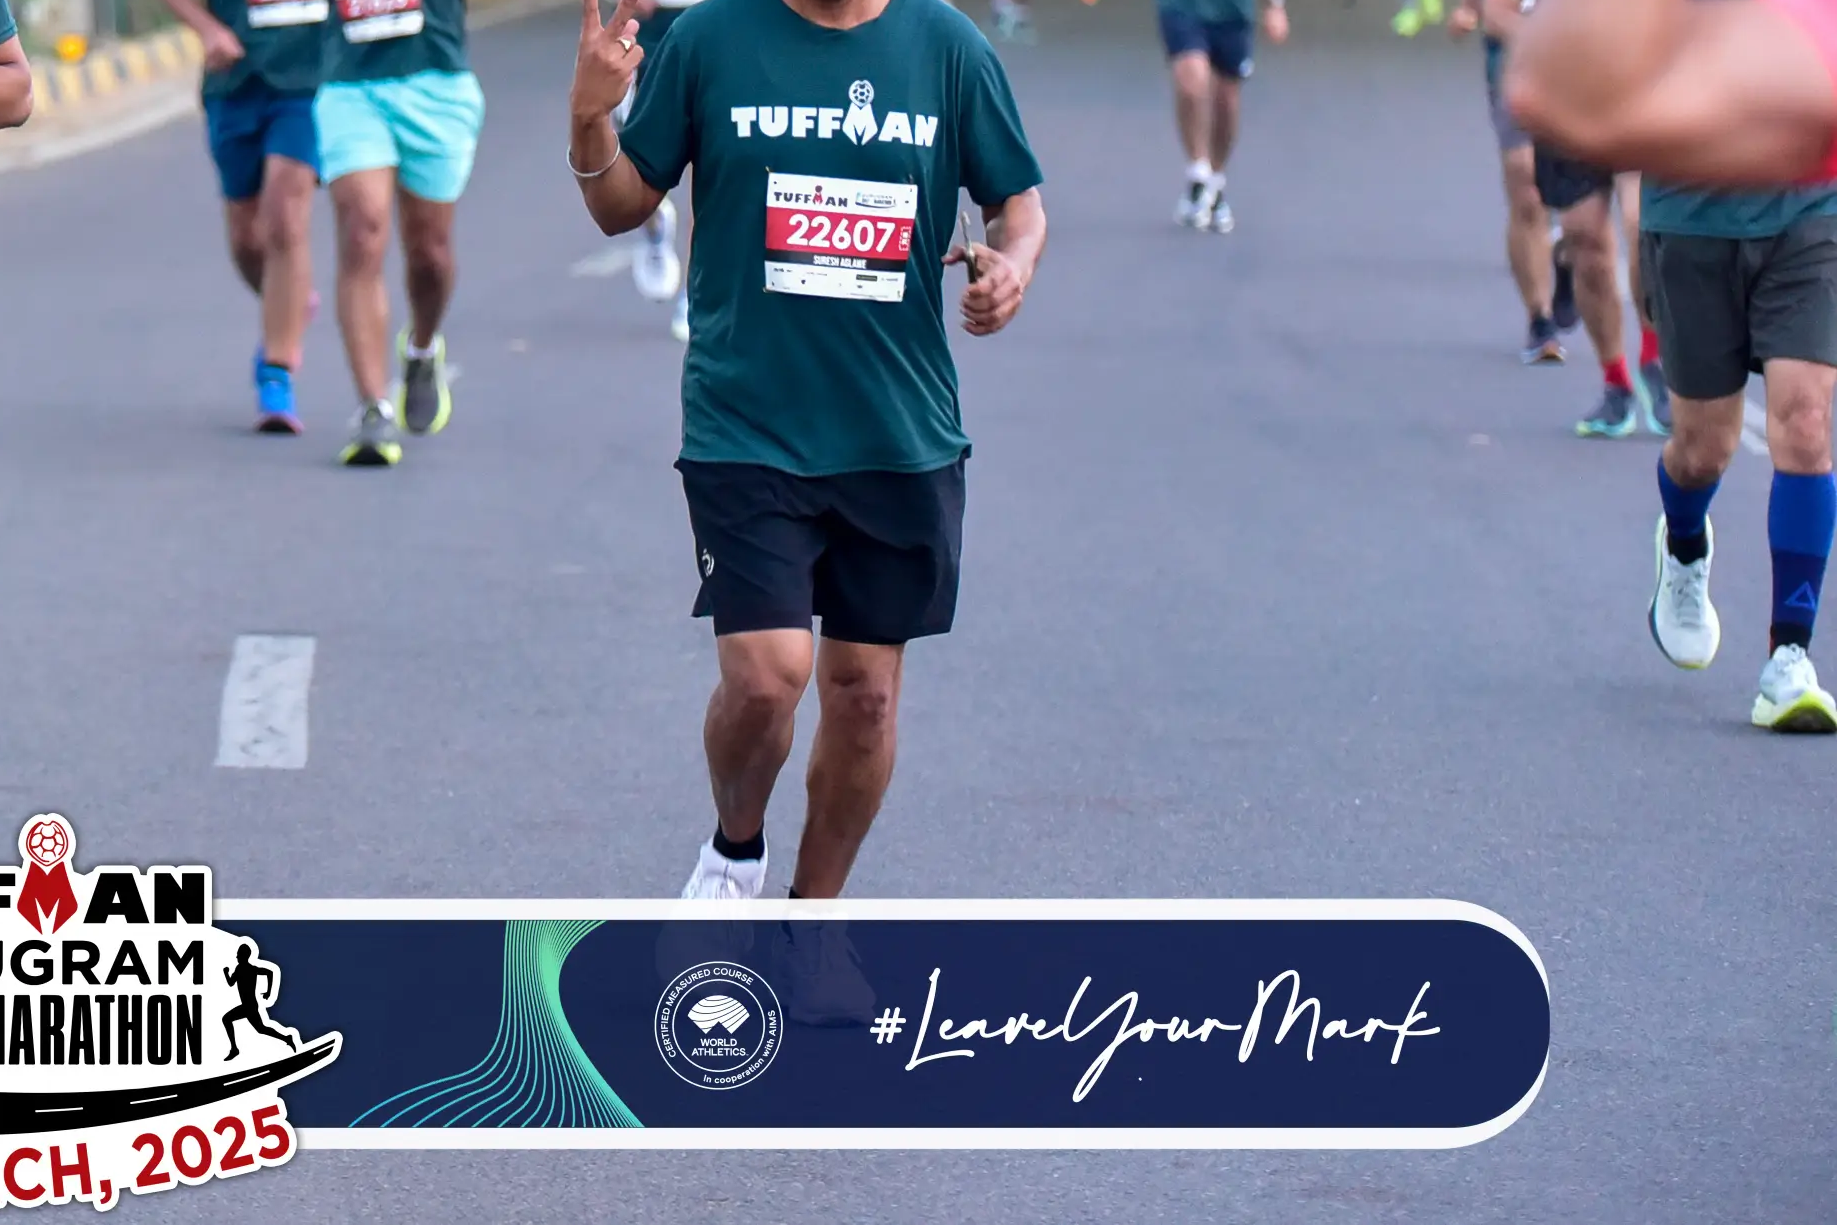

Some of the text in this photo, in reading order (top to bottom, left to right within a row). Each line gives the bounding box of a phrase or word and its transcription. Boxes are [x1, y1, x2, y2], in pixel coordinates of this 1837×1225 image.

[730, 101, 939, 148] TUFFMAN
[773, 191, 849, 208] TUFFMAN
[786, 213, 896, 253] 22607
